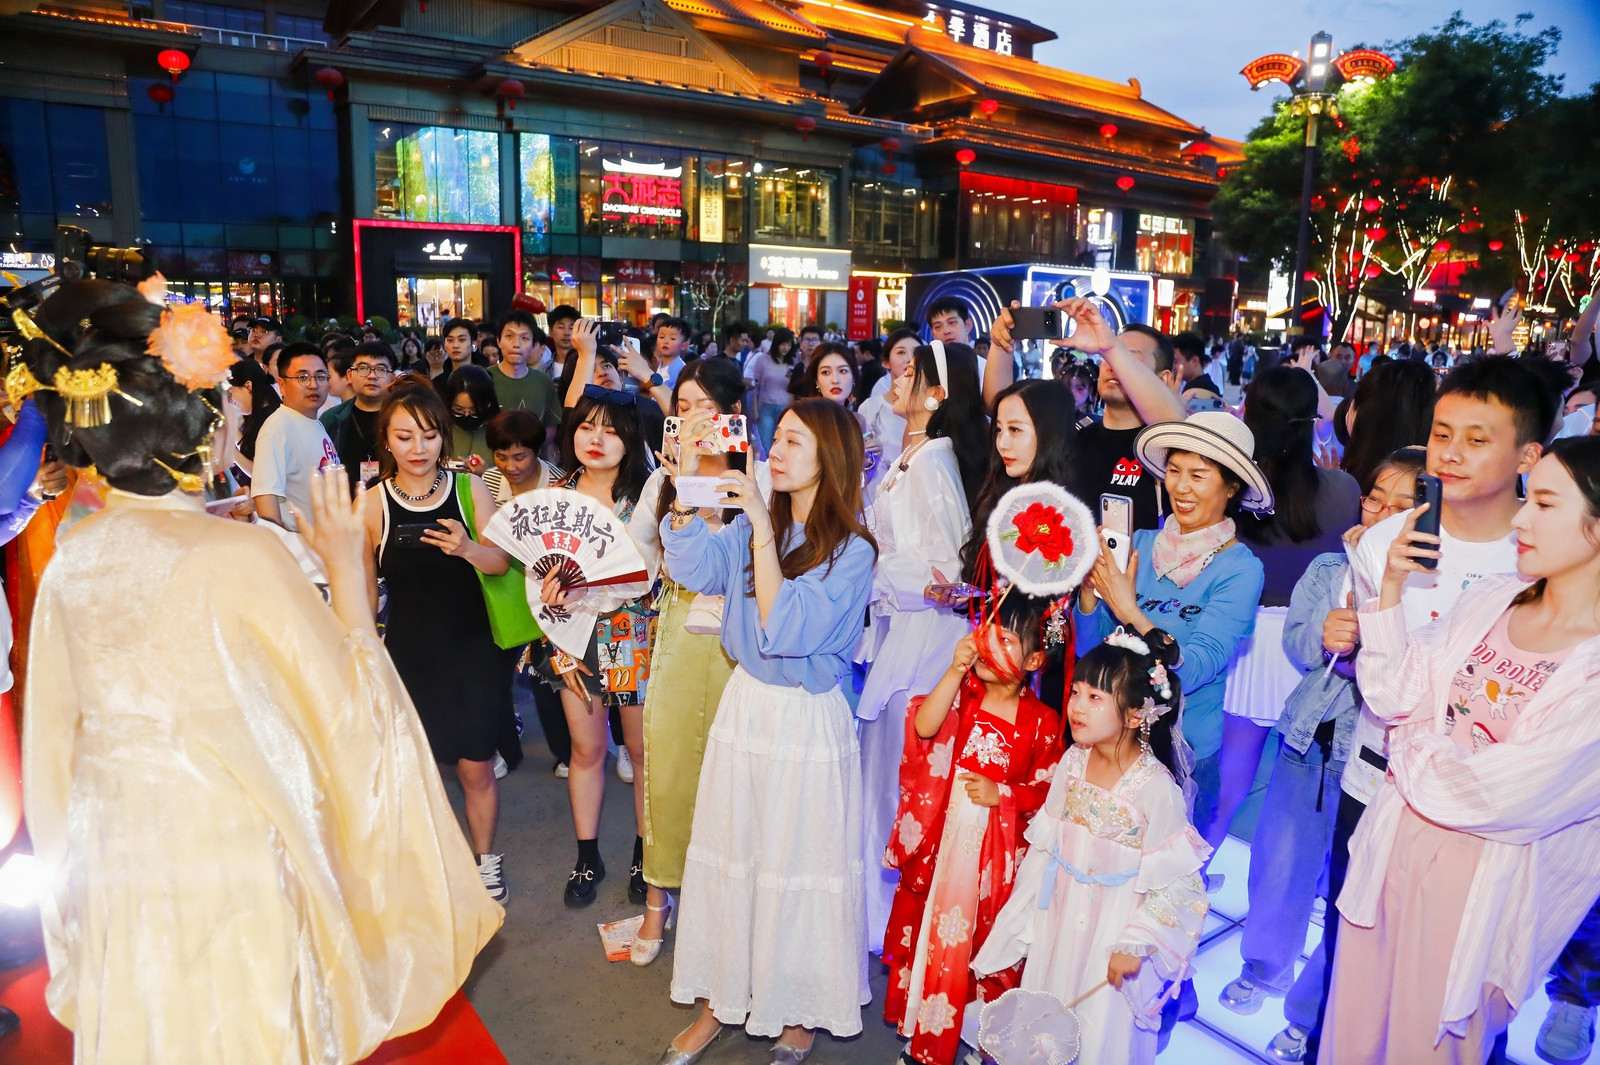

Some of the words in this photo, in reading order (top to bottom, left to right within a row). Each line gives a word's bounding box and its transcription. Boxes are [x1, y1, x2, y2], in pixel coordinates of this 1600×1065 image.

[602, 172, 682, 207] 大城志
[1110, 473, 1141, 487] PLAY
[509, 501, 615, 559] 疯狂星期六
[1493, 658, 1549, 692] CONE
